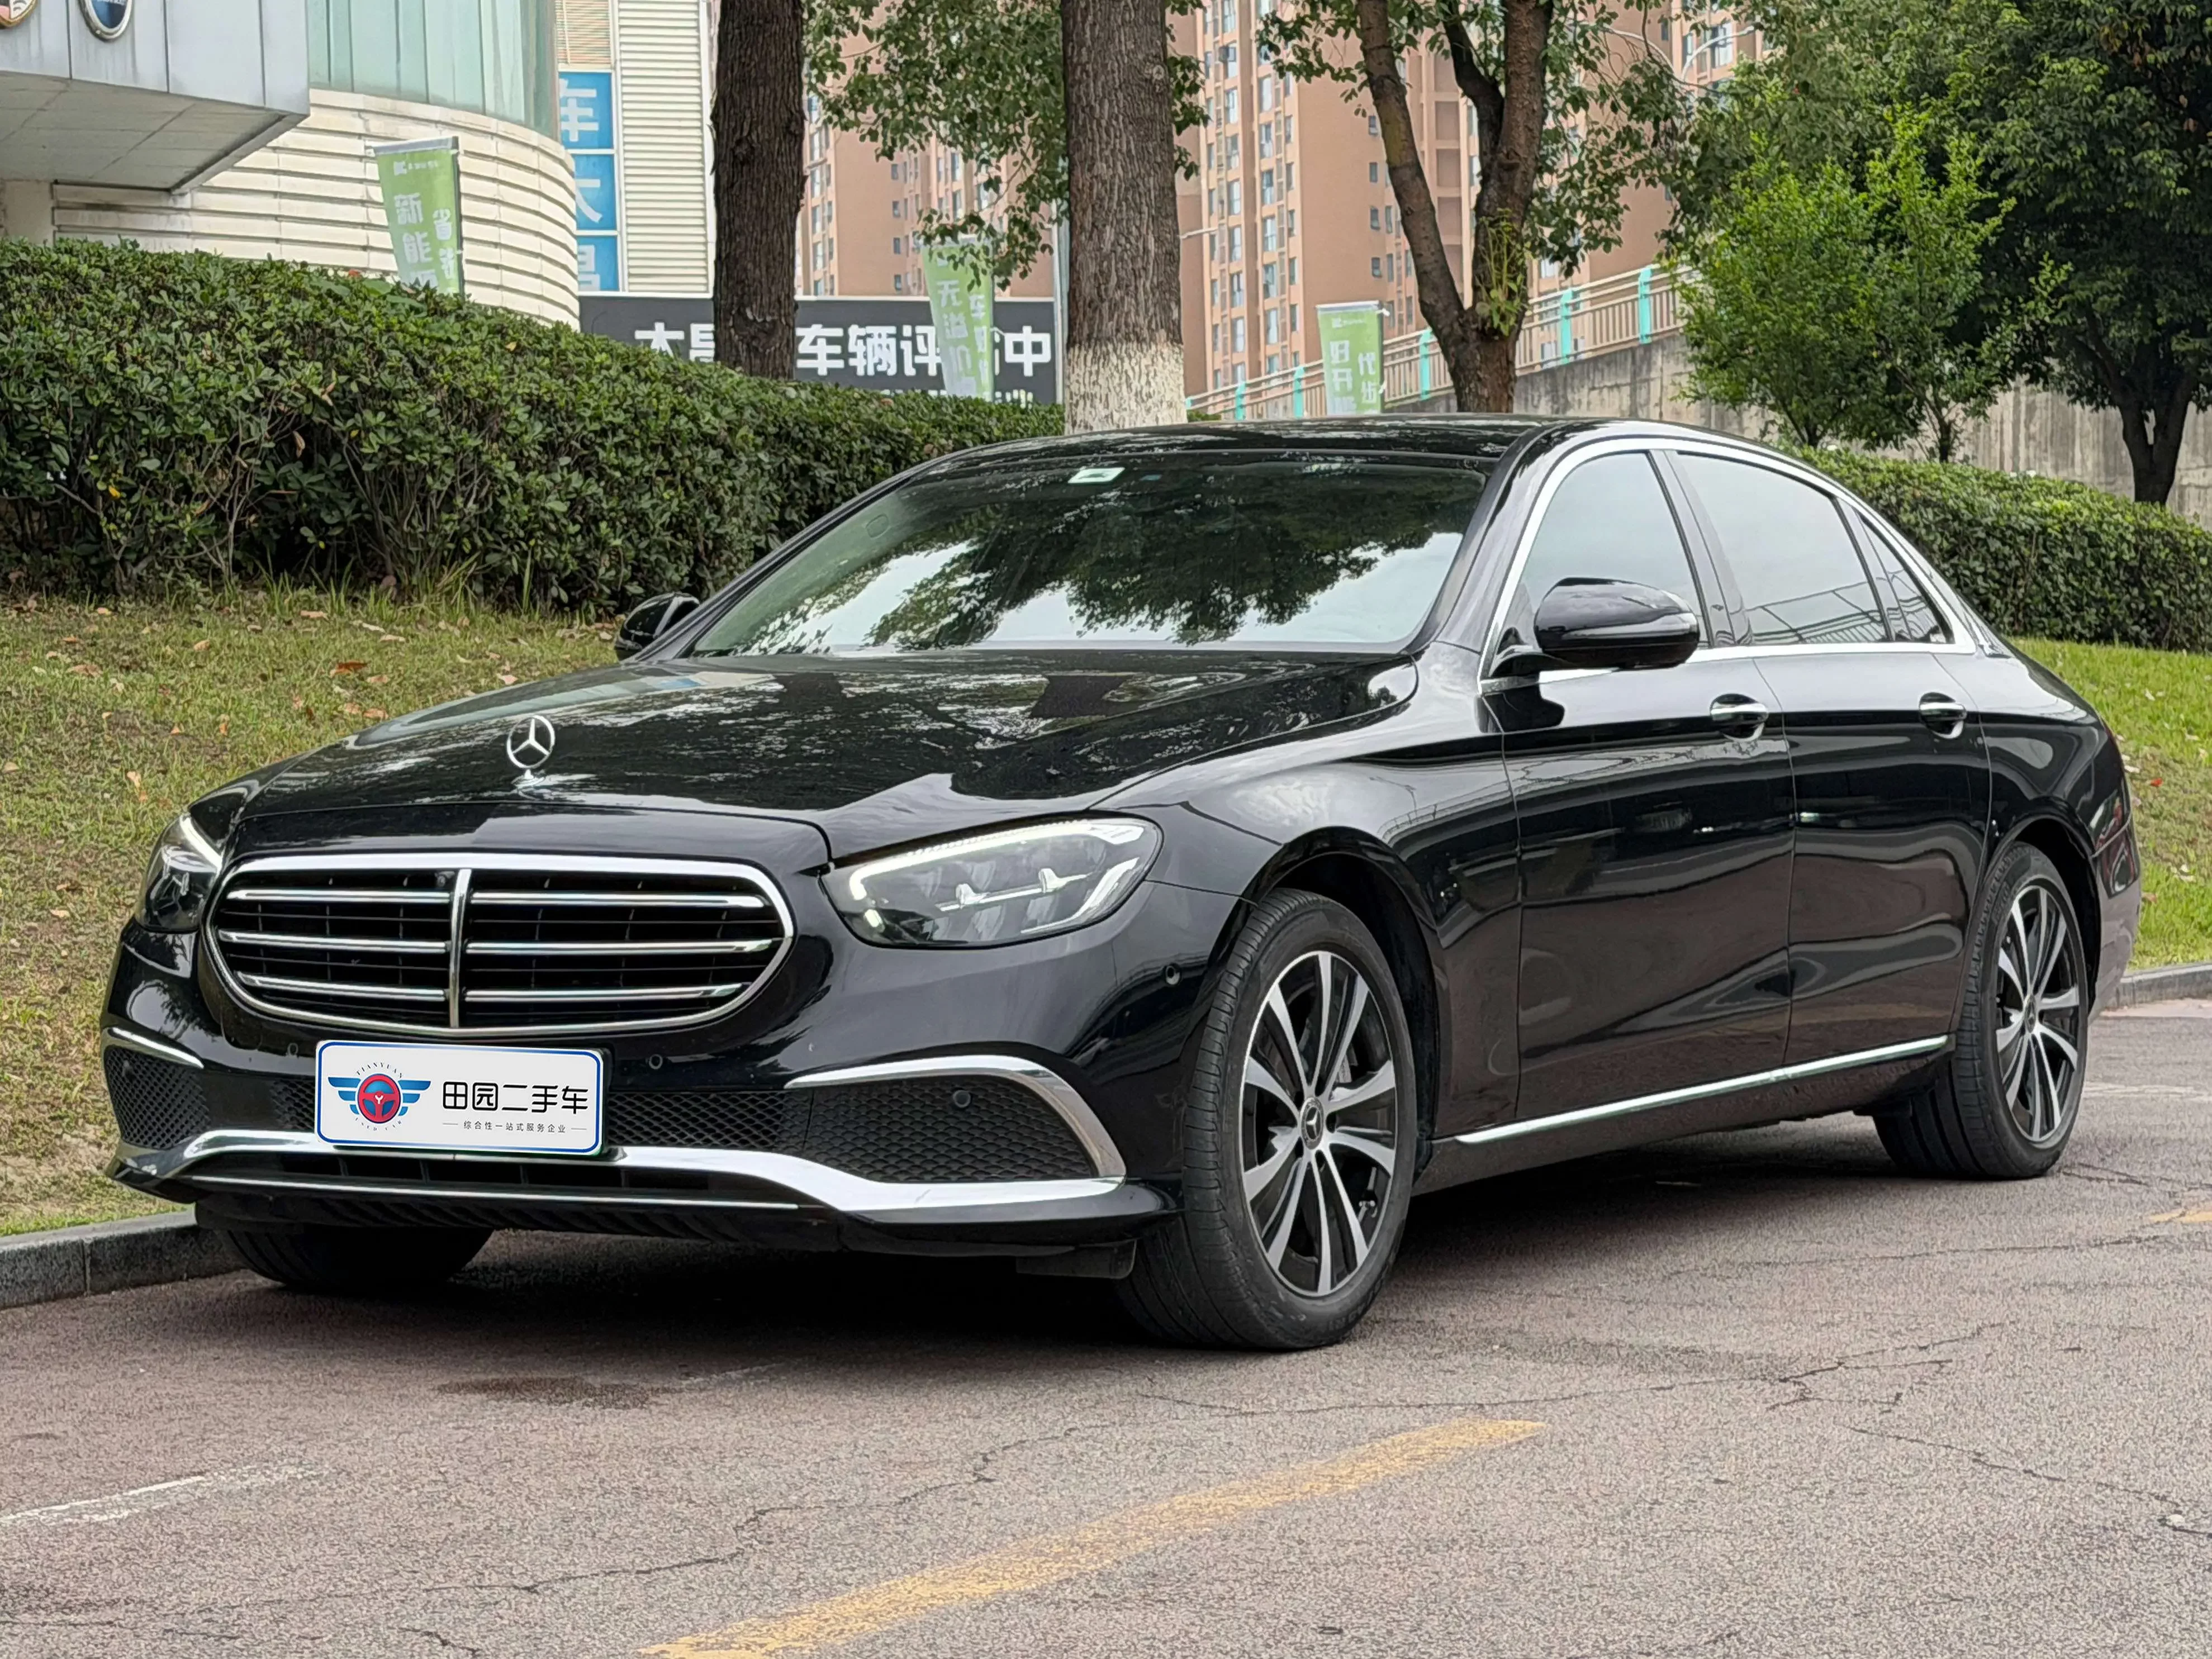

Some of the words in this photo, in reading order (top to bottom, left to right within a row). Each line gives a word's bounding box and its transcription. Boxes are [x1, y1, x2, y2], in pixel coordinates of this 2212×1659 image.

[443, 1081, 588, 1114] 田园二手车
[463, 1120, 566, 1133] 综合性一站式服务企业
